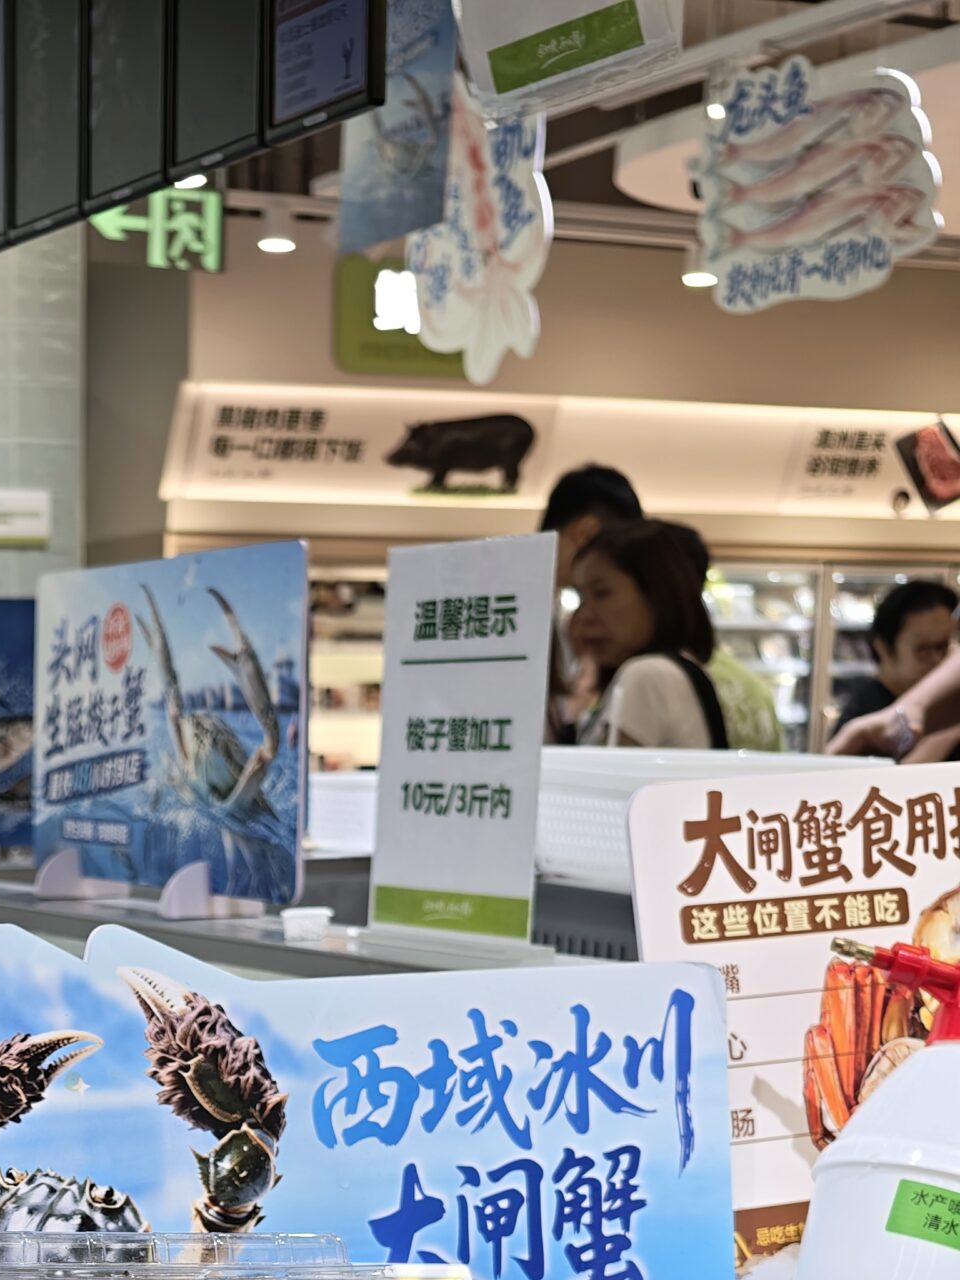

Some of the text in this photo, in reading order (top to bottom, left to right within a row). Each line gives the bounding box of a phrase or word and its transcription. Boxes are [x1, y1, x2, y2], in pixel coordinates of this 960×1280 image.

[412, 594, 519, 642] 温馨提示
[405, 717, 515, 753] 梭子蟹加工
[400, 779, 514, 820] 10元/3斤内
[691, 891, 902, 941] 这些位置不能吃
[311, 988, 696, 1180] 西域冰川
[755, 1221, 804, 1247] 忌吃生
